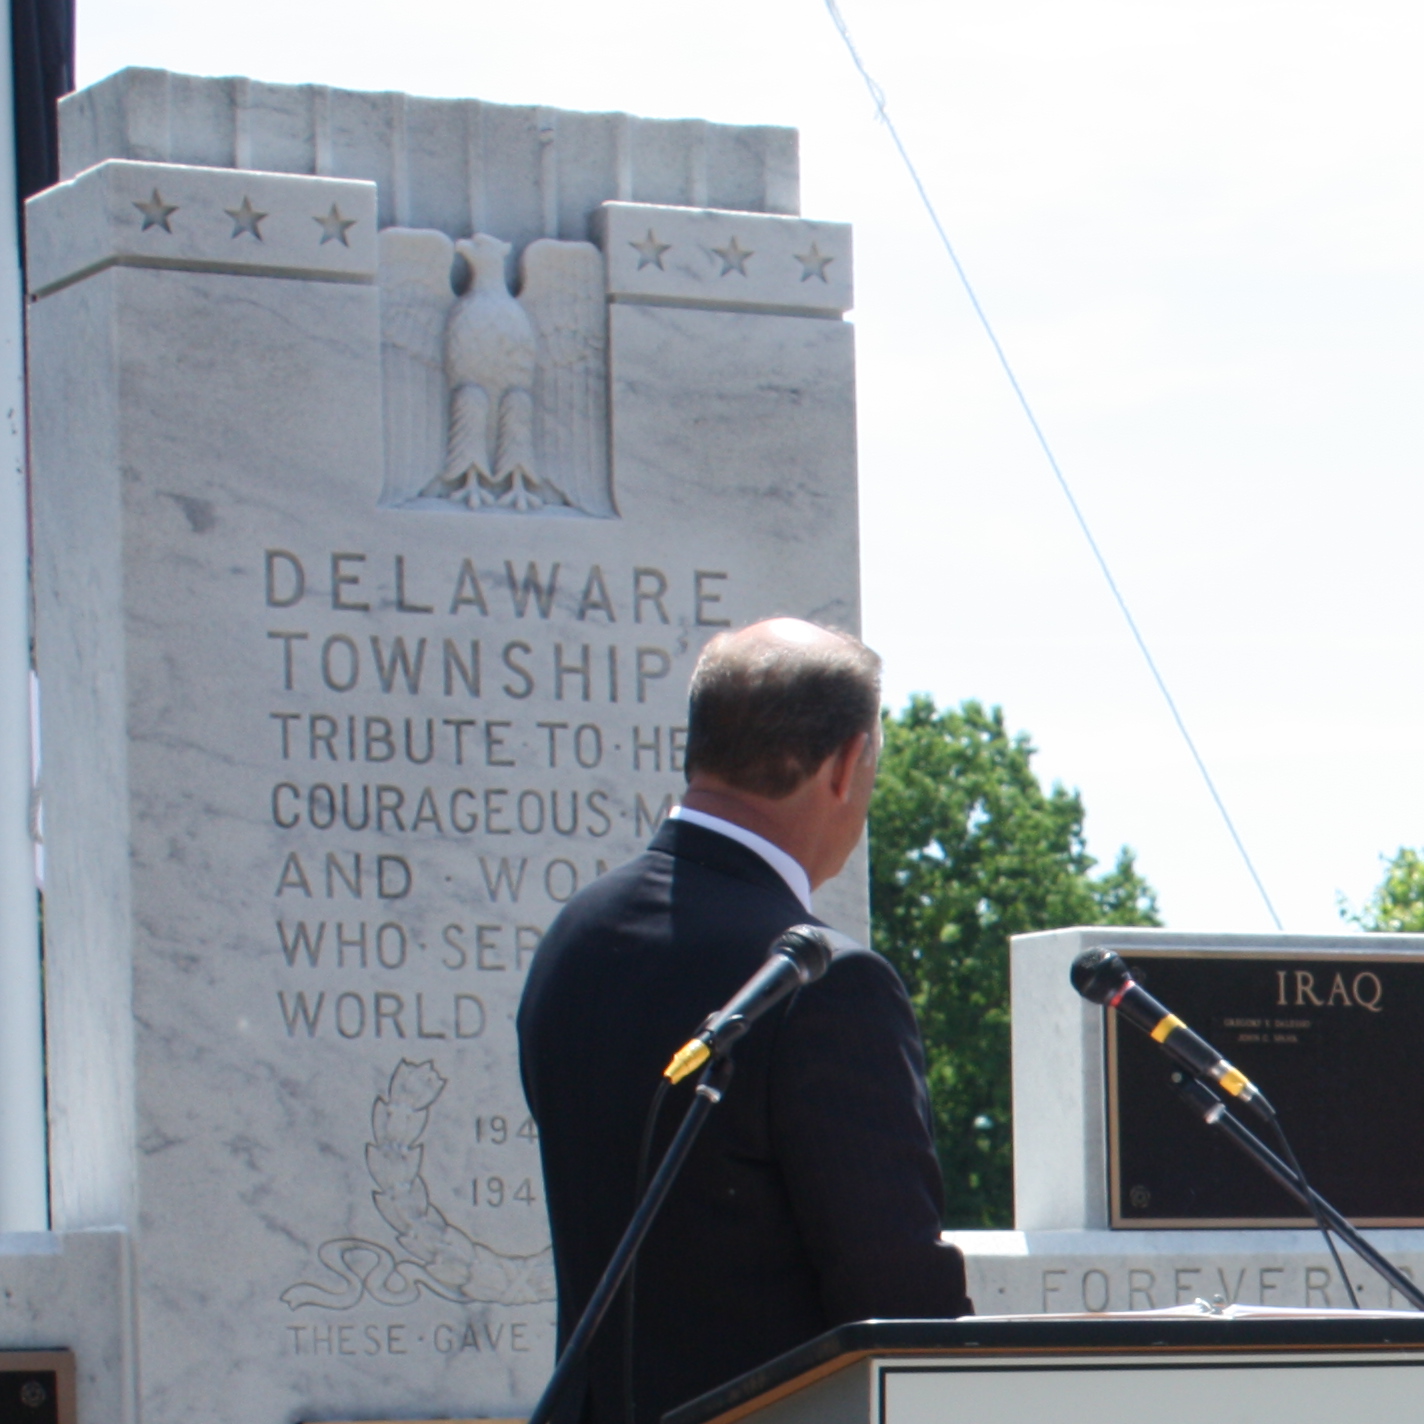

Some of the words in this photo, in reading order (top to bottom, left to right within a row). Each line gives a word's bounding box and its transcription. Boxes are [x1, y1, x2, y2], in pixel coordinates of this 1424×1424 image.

[264, 548, 732, 628] DELAWARE
[269, 711, 516, 768] TRIBUTE
[535, 720, 603, 769] TO
[270, 780, 612, 838] COURAGEOUS
[273, 851, 413, 900] AND
[275, 919, 408, 970] WHO
[276, 990, 487, 1040] WORLD
[1275, 969, 1384, 1013] IRAQ
[1040, 1265, 1332, 1313] FOREVER
[285, 1323, 407, 1356] THESE
[433, 1322, 530, 1354] GAVE
